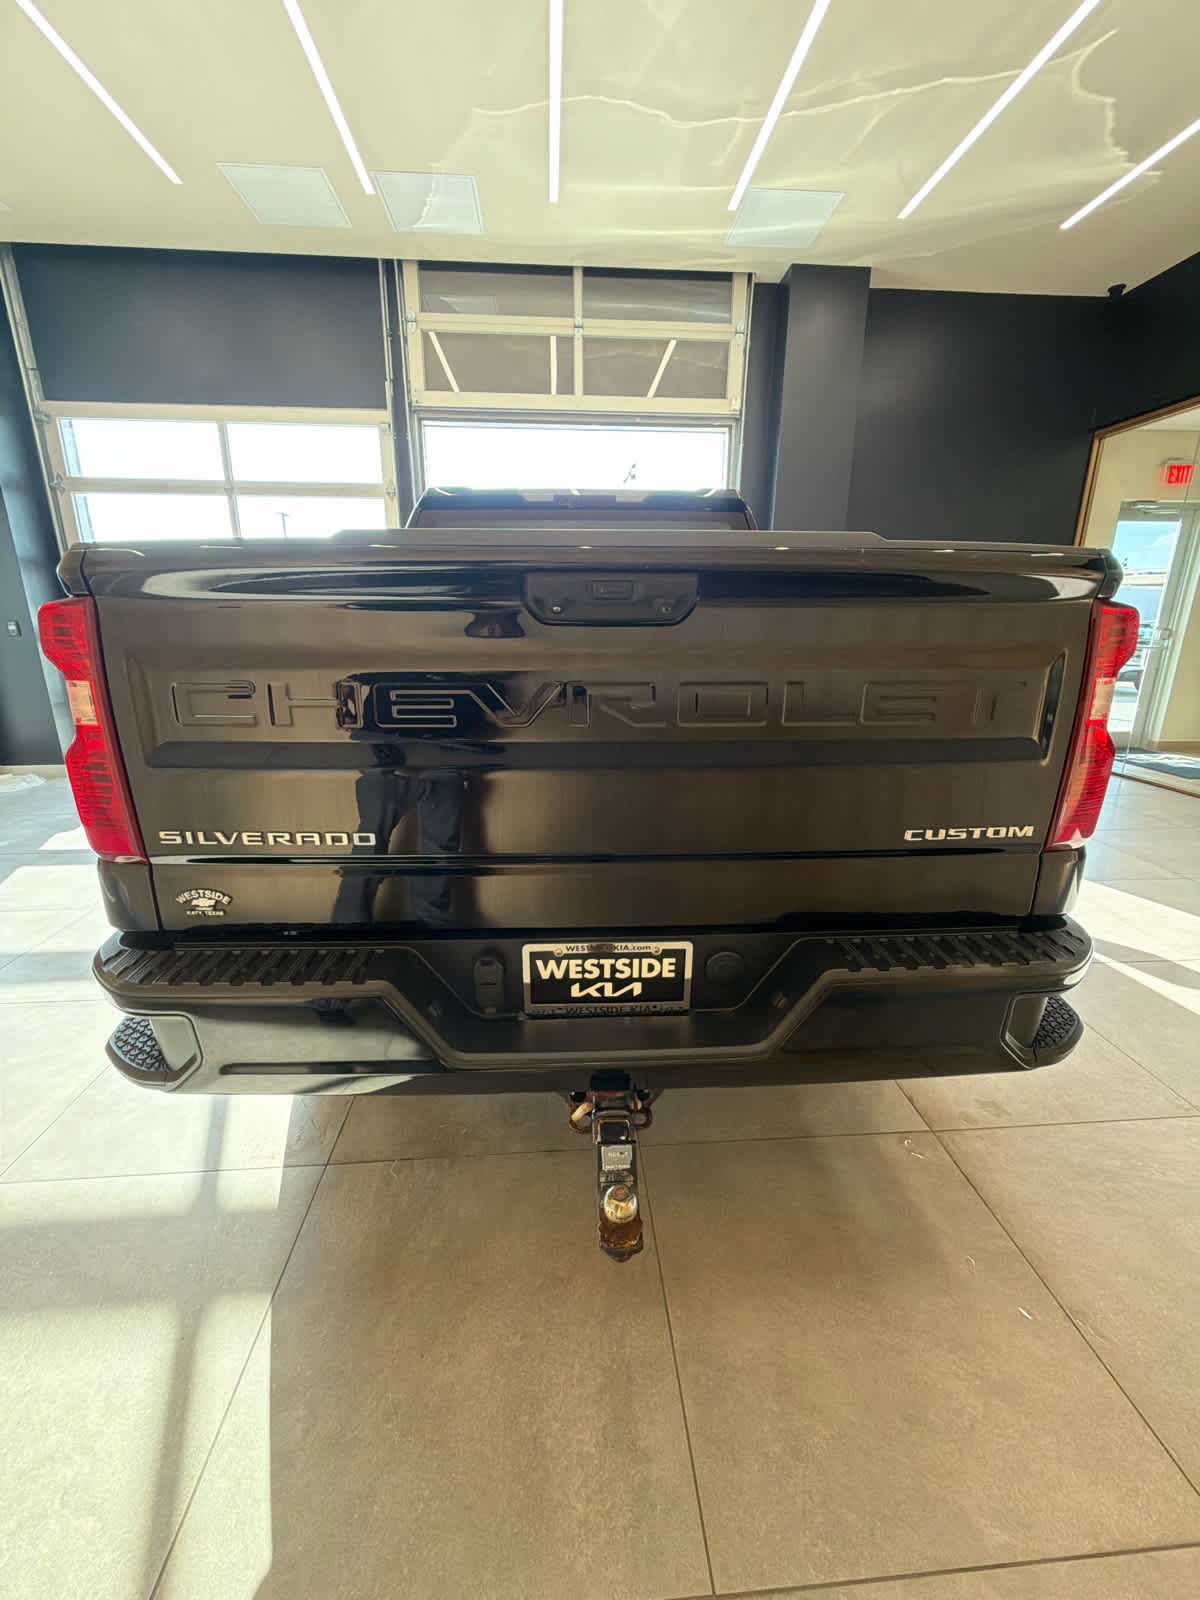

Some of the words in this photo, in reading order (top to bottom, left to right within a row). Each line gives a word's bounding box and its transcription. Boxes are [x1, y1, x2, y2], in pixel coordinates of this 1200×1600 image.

[1167, 464, 1192, 484] EXIT
[158, 831, 377, 846] SILVERADO
[904, 825, 1035, 841] CUSTOM
[175, 888, 232, 905] WESTSIDE
[535, 957, 677, 980] WESTSIDE
[570, 982, 642, 998] KIA
